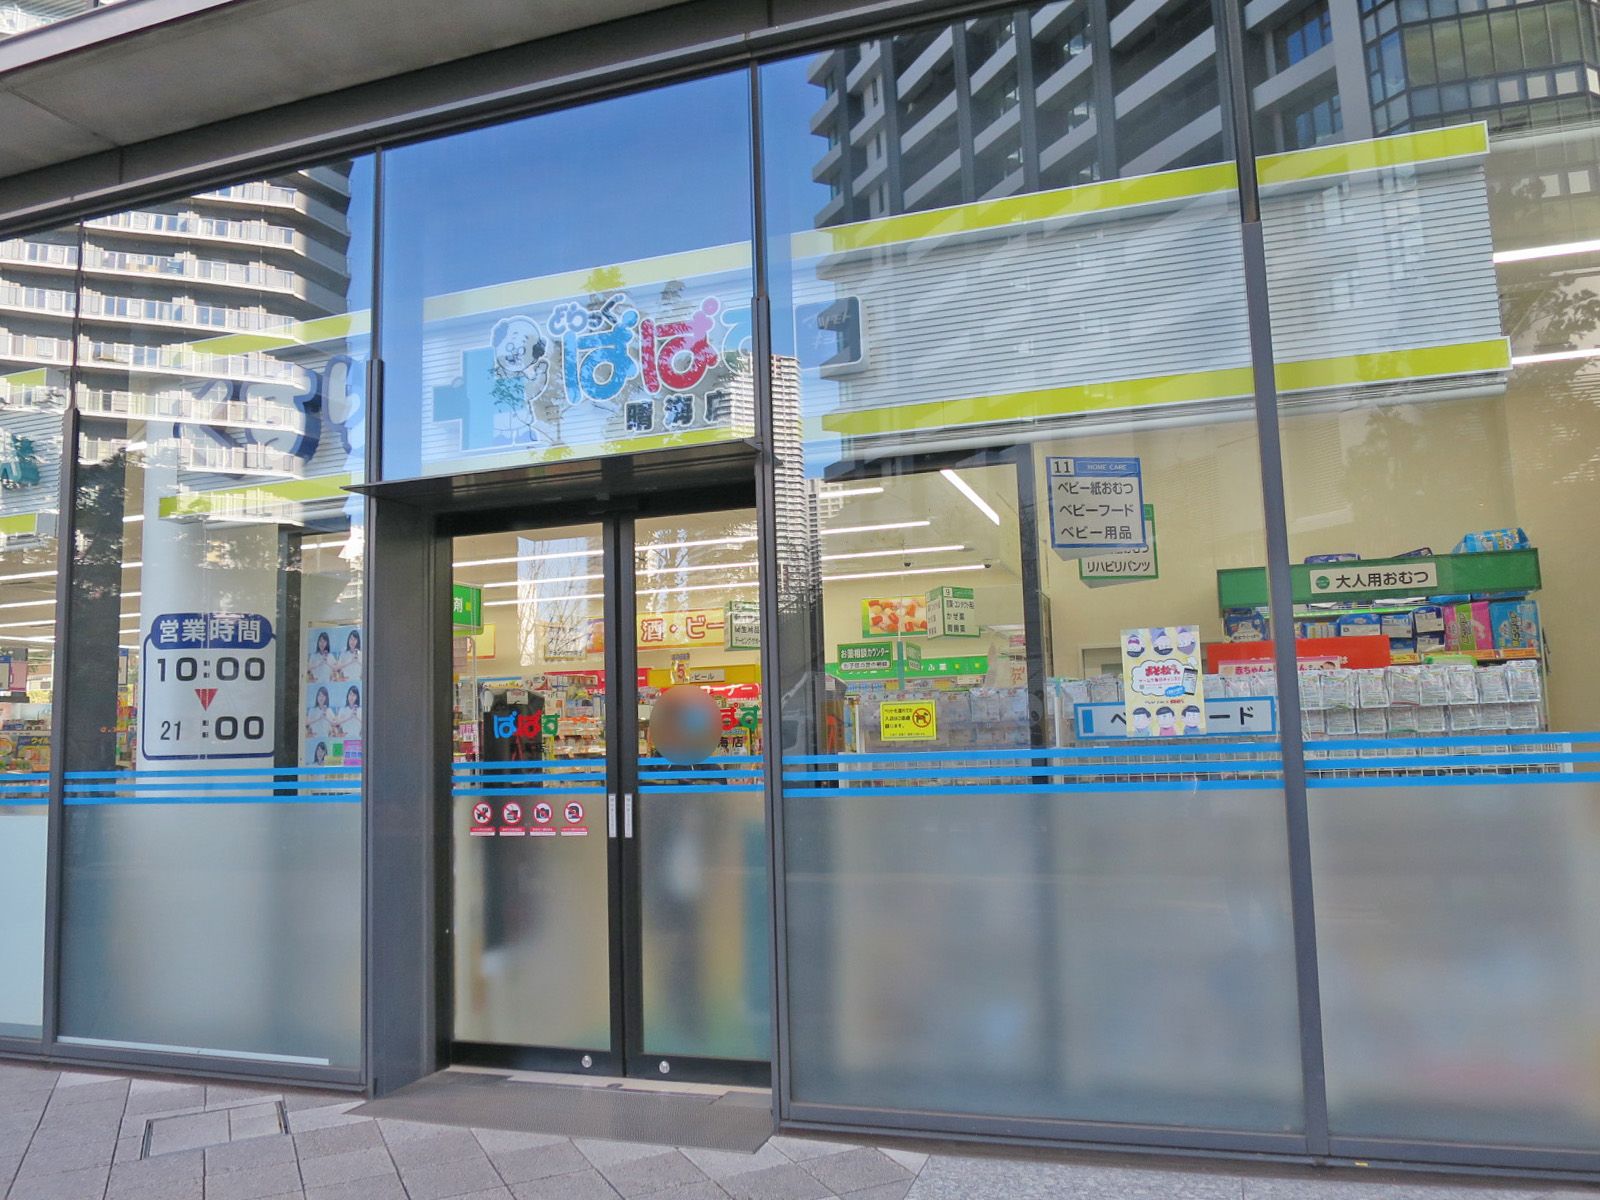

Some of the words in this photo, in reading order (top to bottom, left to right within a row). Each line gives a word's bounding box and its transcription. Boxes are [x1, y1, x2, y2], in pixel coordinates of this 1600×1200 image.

[1054, 461, 1071, 473] 11
[1057, 481, 1134, 495] ベビー紙おむつ
[1060, 504, 1134, 517] ベビーフード
[1061, 526, 1132, 539] ベビー用品
[1087, 561, 1151, 573] リハビリパンツ
[1335, 571, 1429, 589] 大人用おむつ
[159, 618, 261, 643] 営業時間
[157, 657, 266, 682] 10:00
